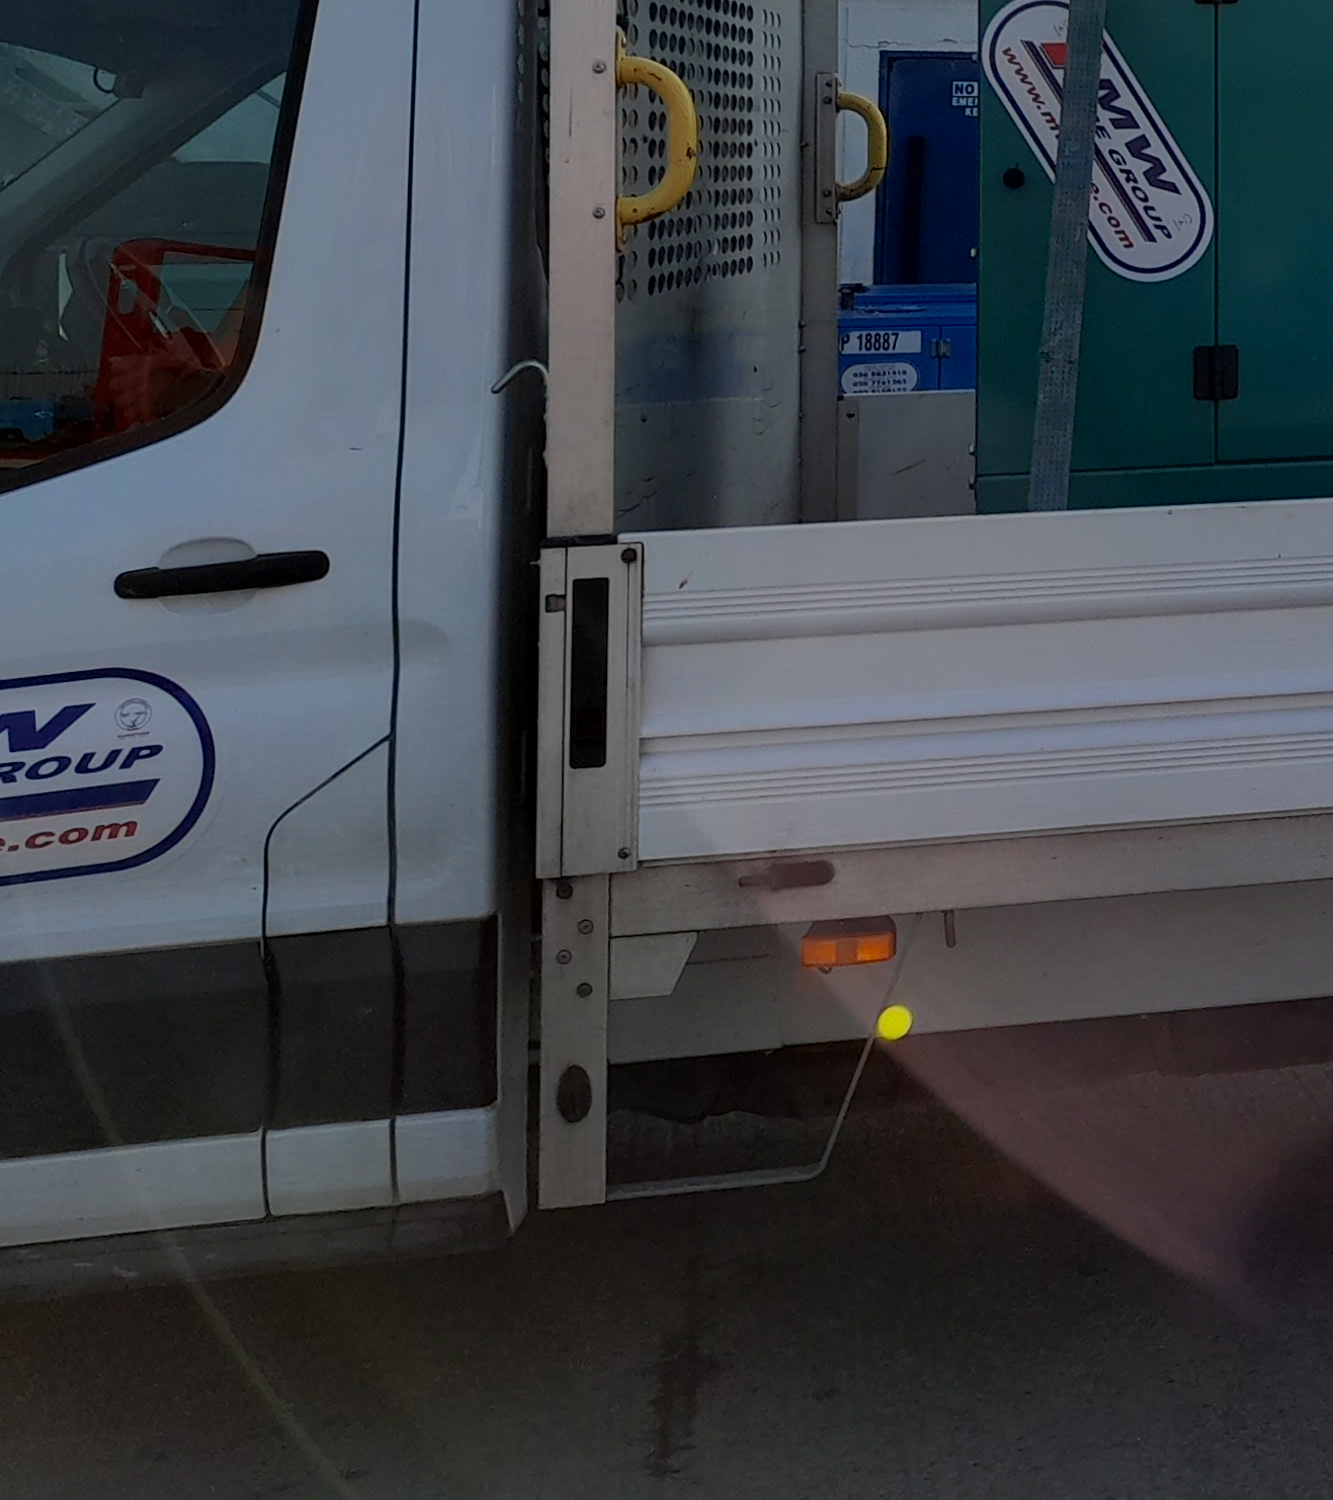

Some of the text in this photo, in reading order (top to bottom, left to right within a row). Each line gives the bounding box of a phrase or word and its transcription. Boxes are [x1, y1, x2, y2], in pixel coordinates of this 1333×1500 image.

[954, 83, 975, 95] NO
[1101, 78, 1182, 195] MW
[1108, 148, 1172, 240] GROUP
[856, 332, 900, 351] 18887
